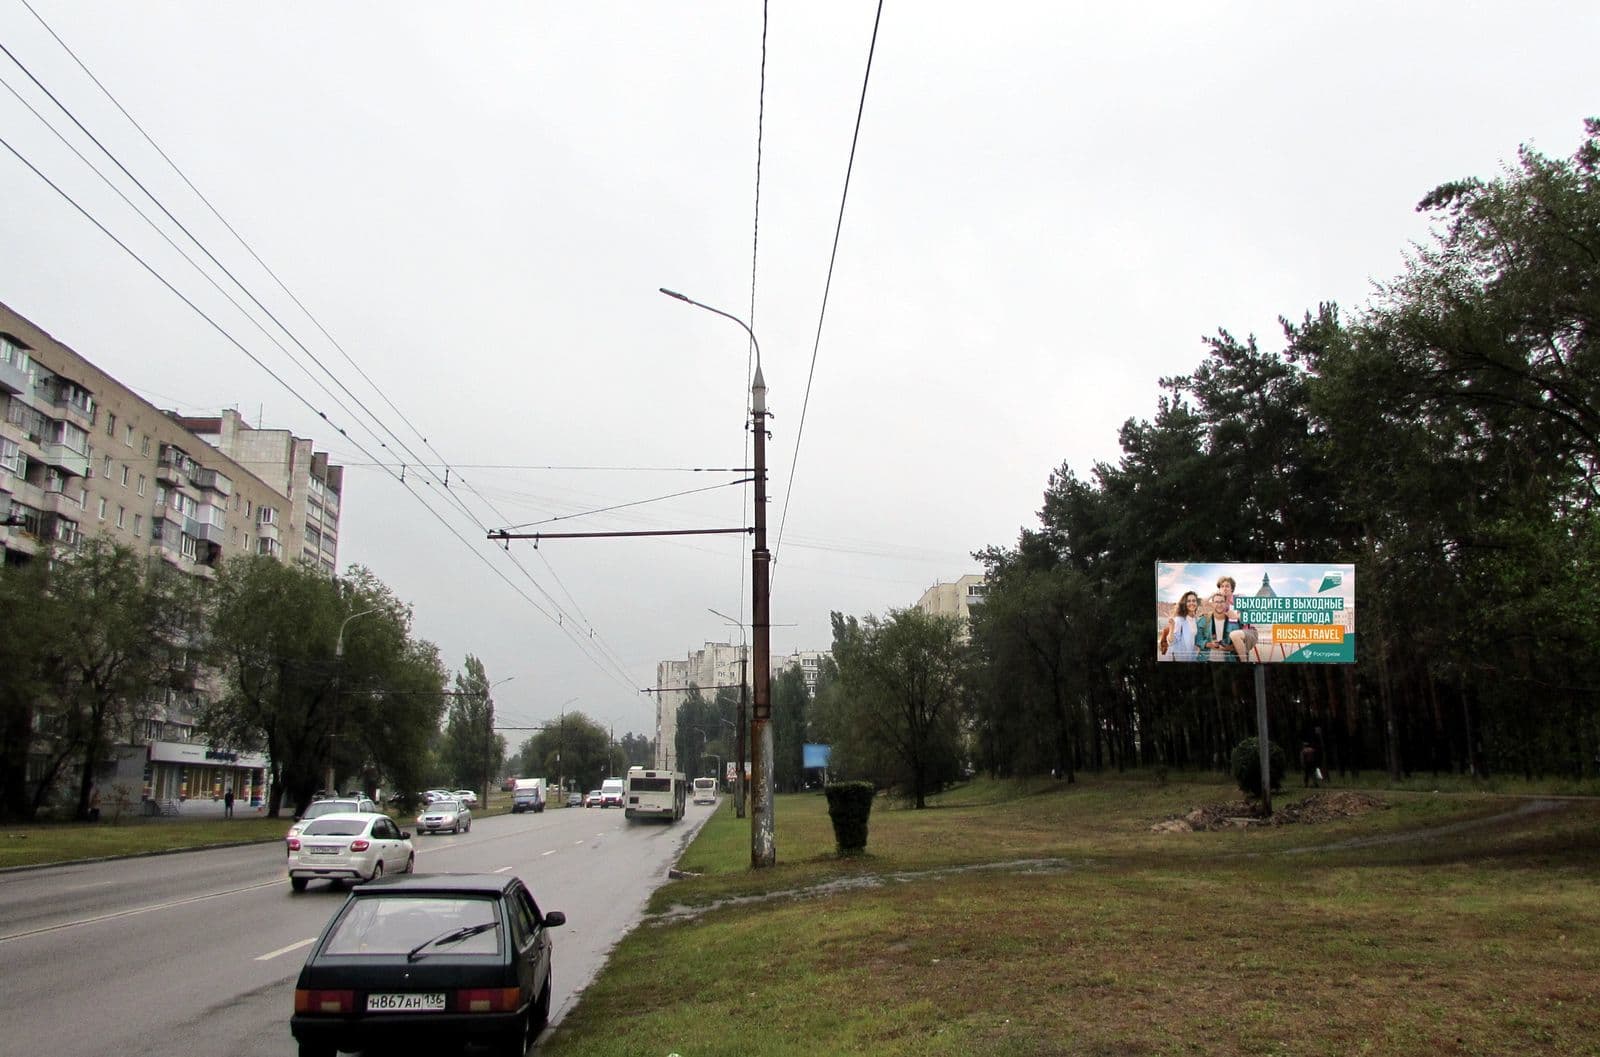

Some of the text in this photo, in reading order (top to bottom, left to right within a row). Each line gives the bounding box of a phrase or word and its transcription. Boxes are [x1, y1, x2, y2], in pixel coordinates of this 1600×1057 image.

[1236, 597, 1343, 610] ВЫХОДИТЕ В ВЫХОДНЫЕ
[1242, 611, 1331, 624] В СОСЕДНИЕ ГОРОДА
[1276, 628, 1340, 640] RUSSIA.TRAVEL
[424, 994, 441, 1004] 136
